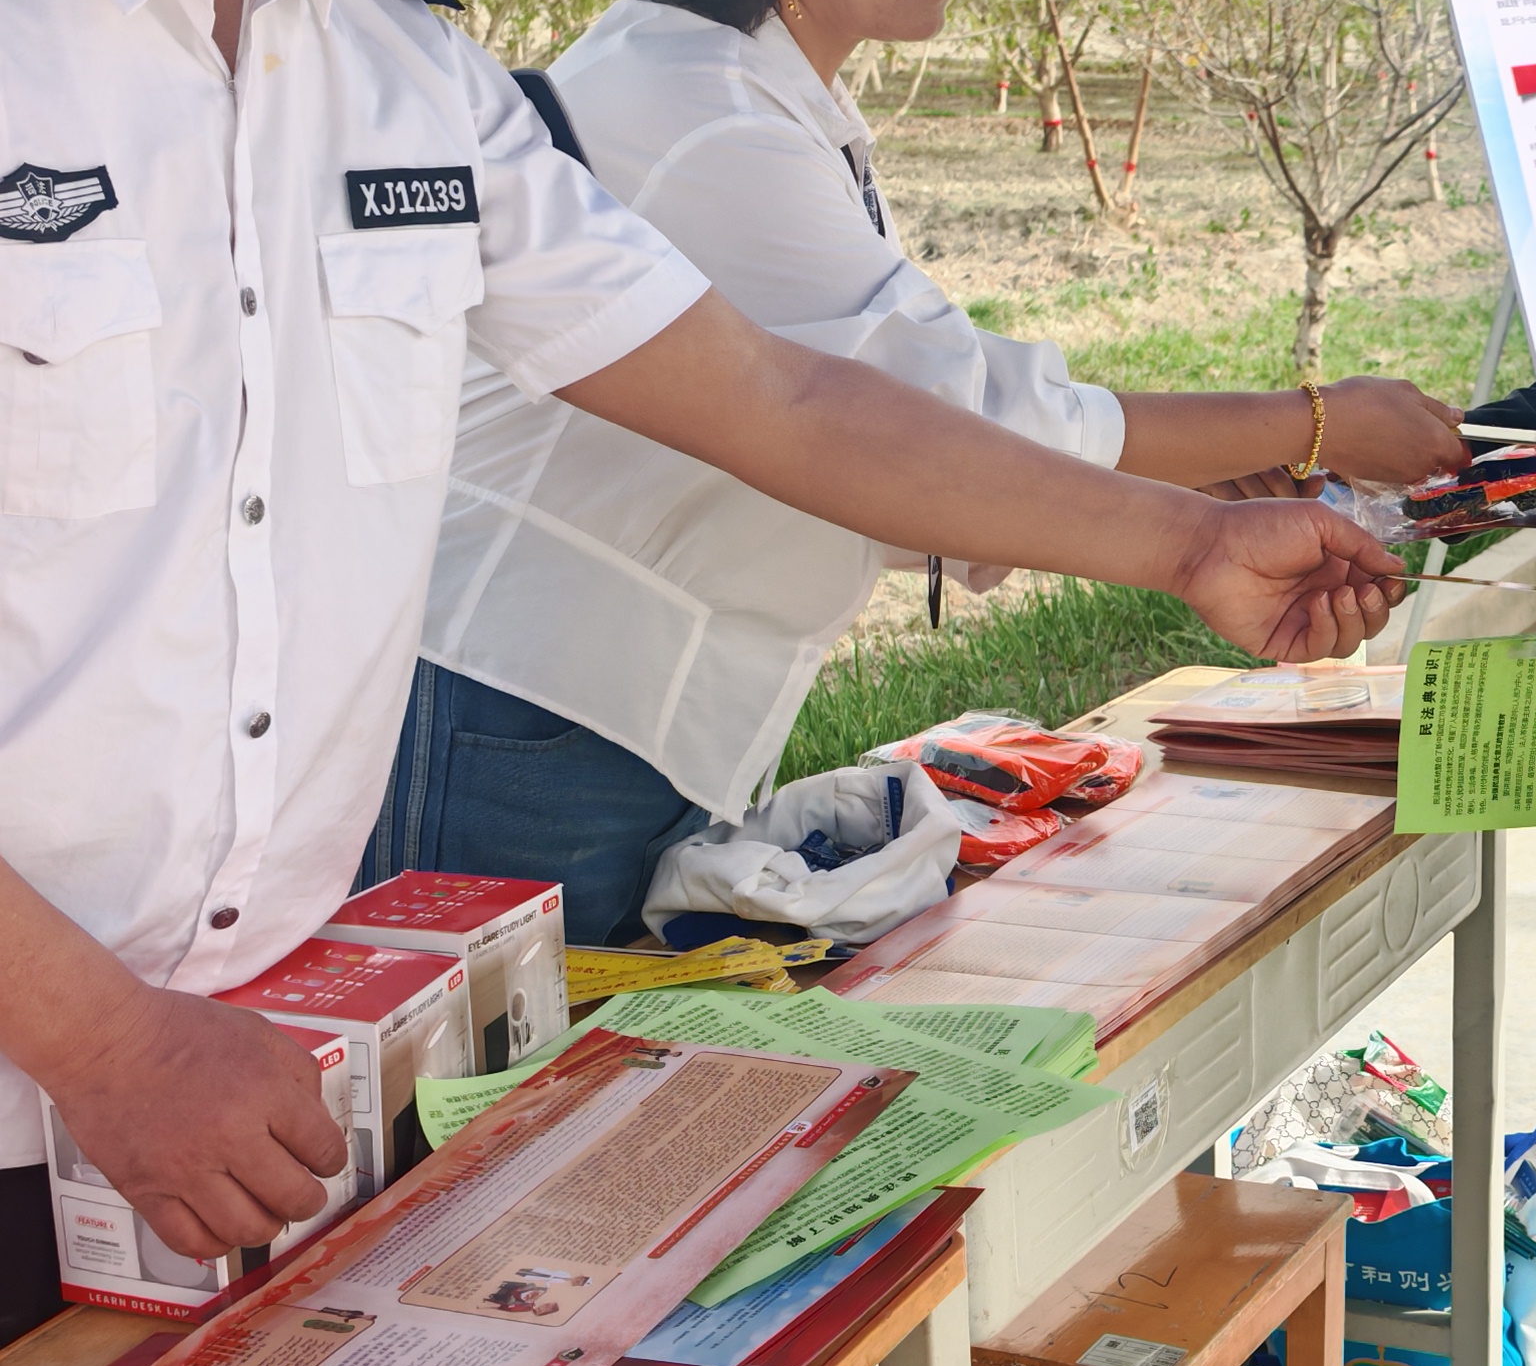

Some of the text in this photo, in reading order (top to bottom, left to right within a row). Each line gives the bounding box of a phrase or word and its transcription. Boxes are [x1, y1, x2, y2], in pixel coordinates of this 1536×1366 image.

[360, 180, 466, 217] XJ12139
[1418, 646, 1442, 736] 民法典知识了
[543, 896, 558, 914] LED
[468, 910, 538, 953] EYE-CARE STUDY LIGHT
[450, 972, 463, 990] LED
[381, 988, 444, 1042] EYE-CARE STUDY LIGHT
[323, 1051, 341, 1068] LED
[1344, 1264, 1452, 1292] 和则
[88, 1291, 127, 1308] LEARN
[131, 1299, 162, 1314] DESK
